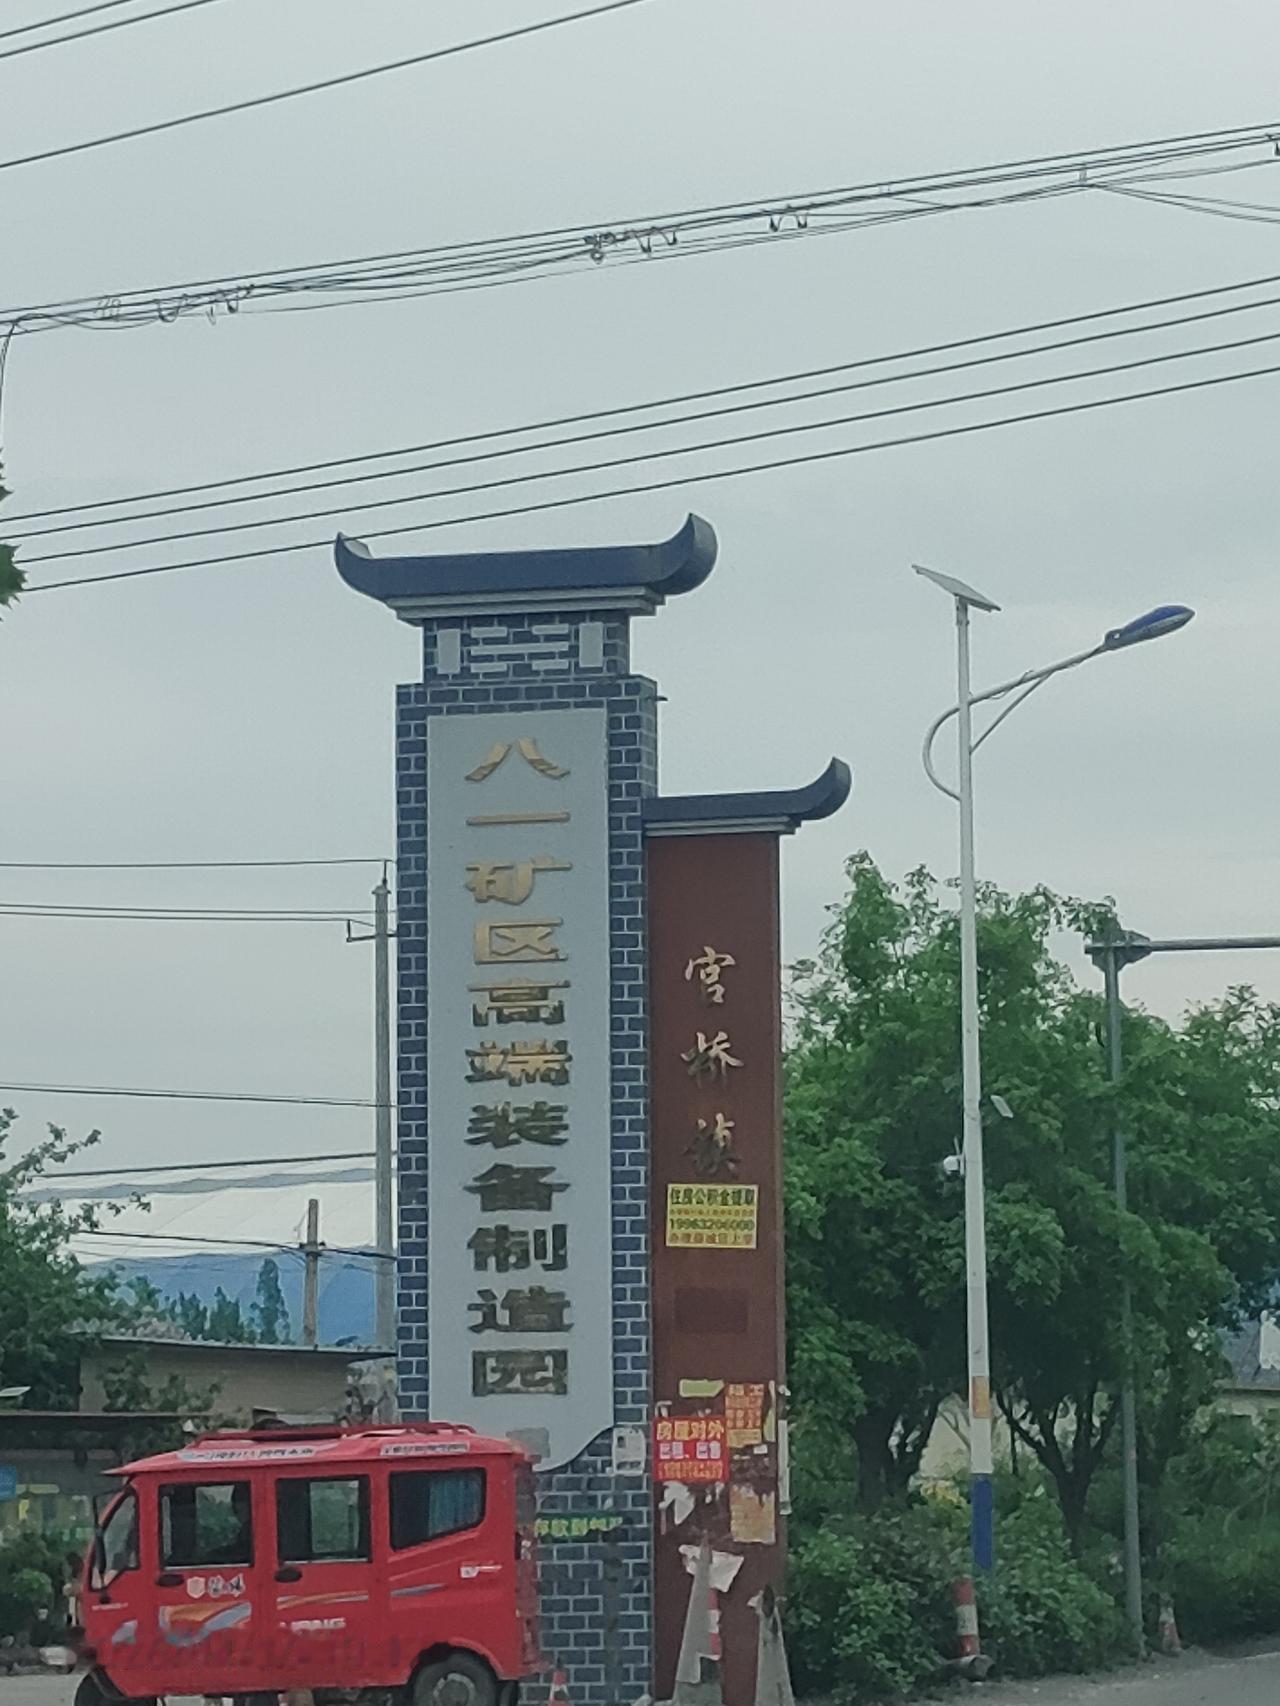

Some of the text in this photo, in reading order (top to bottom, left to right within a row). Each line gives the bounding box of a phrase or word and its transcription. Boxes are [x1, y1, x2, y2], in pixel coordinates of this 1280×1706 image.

[464, 737, 573, 1397] 八一矿区高端装备制造园
